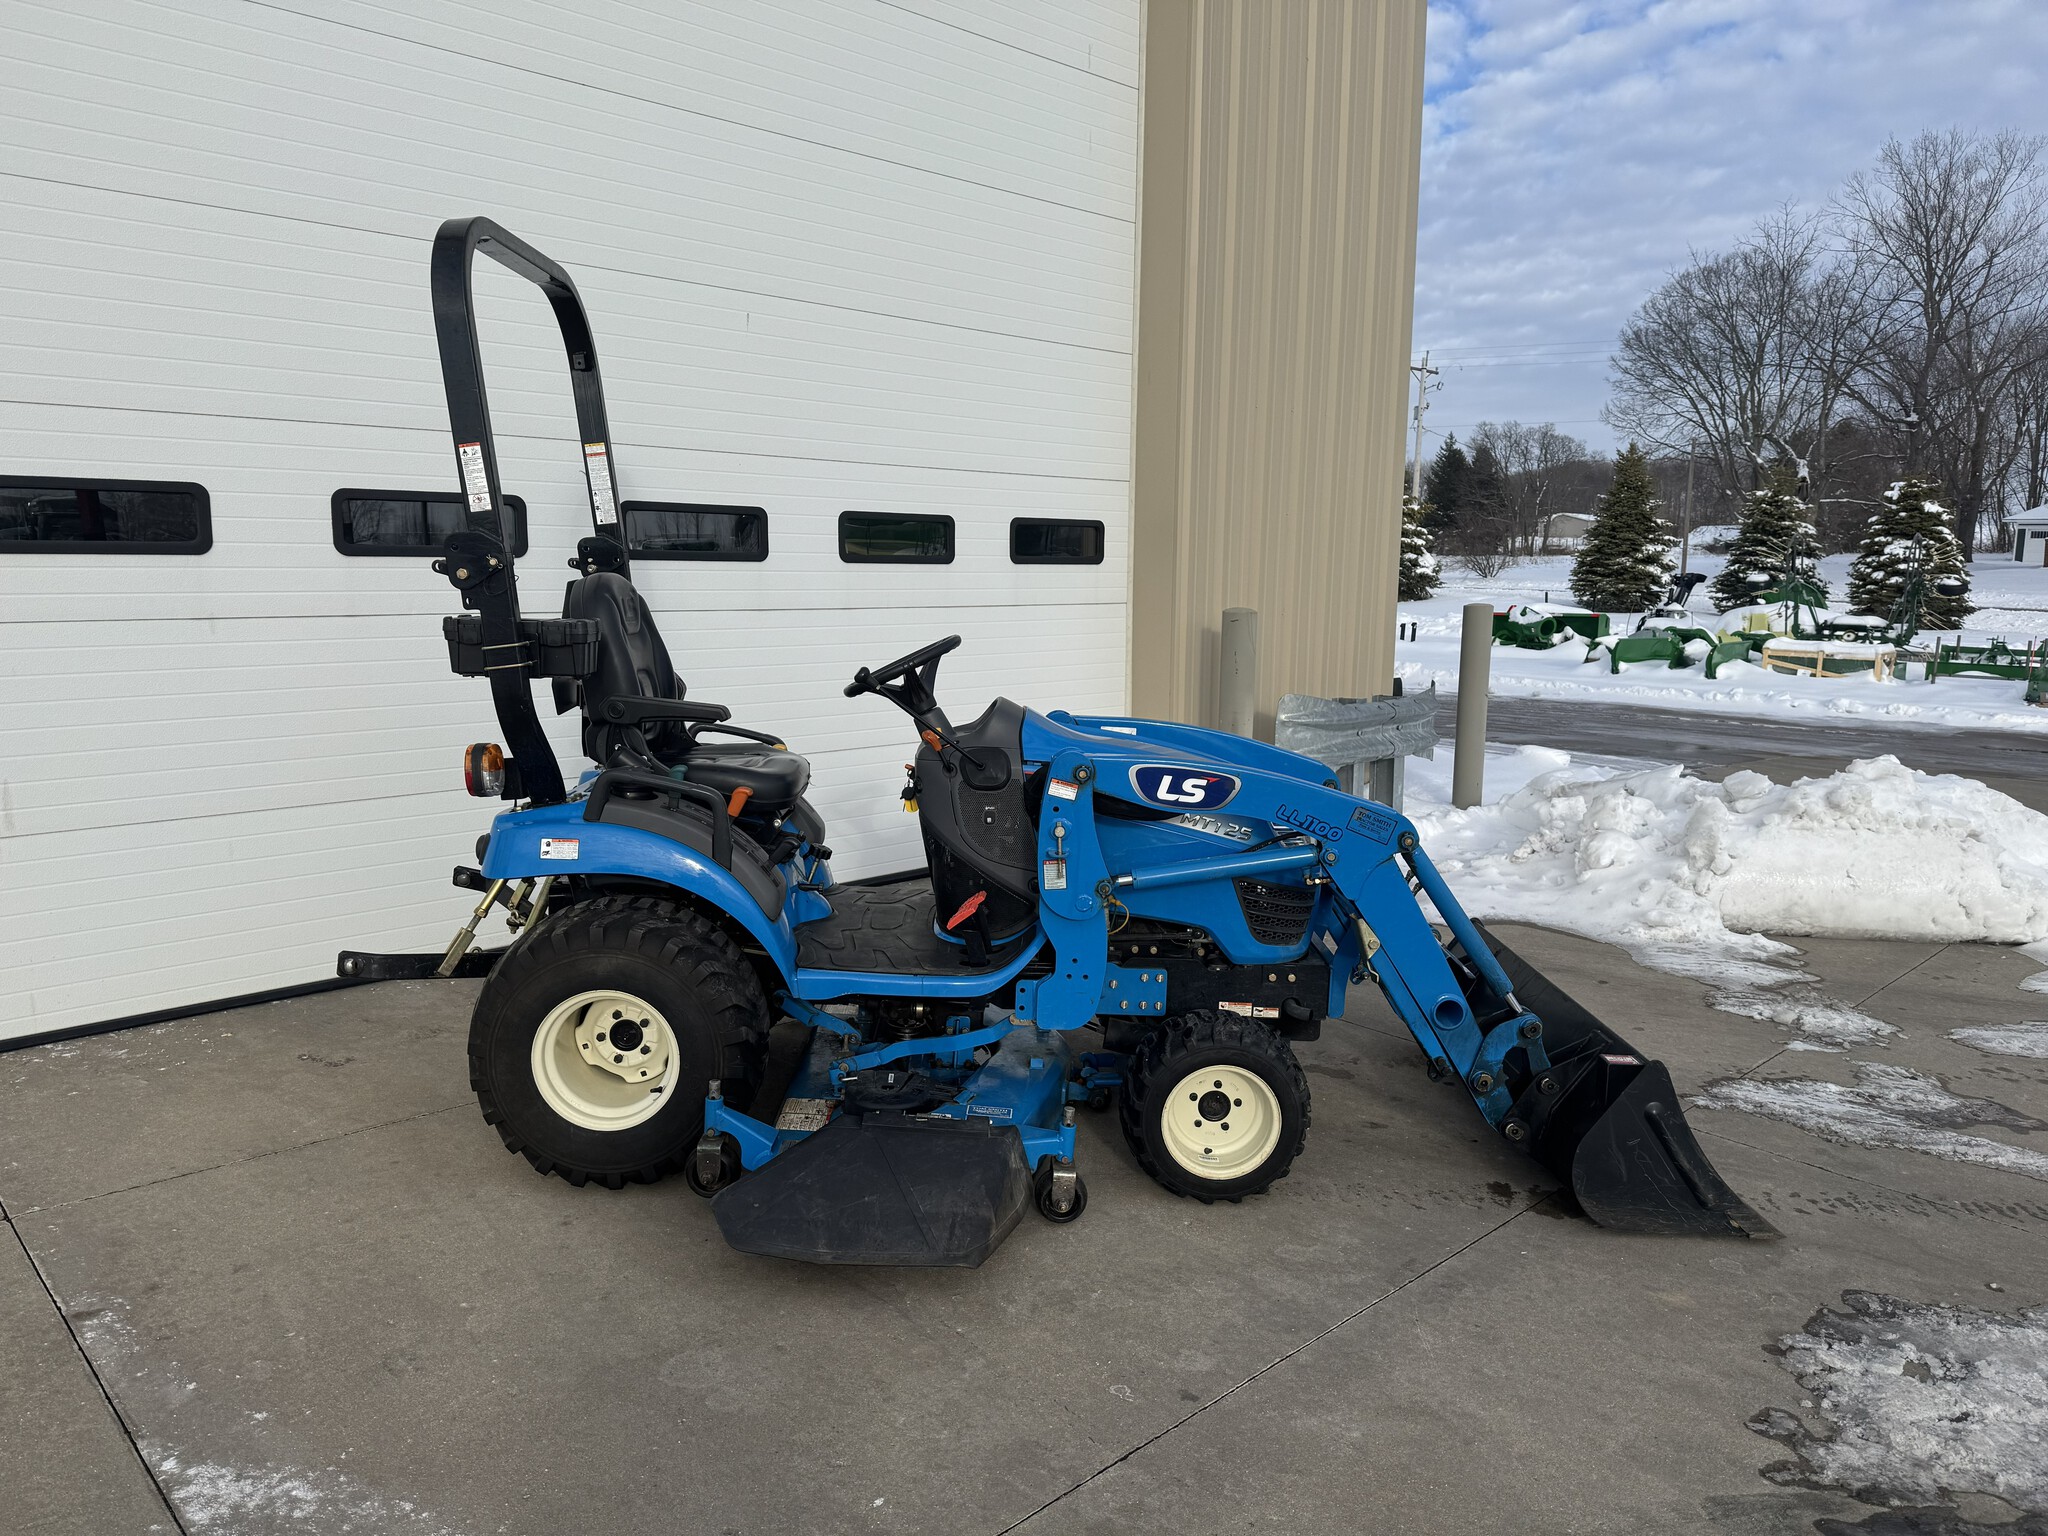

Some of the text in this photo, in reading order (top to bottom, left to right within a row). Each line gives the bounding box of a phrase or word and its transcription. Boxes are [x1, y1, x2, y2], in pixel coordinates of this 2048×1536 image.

[1156, 774, 1208, 803] LS
[1180, 812, 1254, 841] MT125
[1275, 803, 1344, 842] LL1100
[1358, 811, 1392, 828] TOM SMITH
